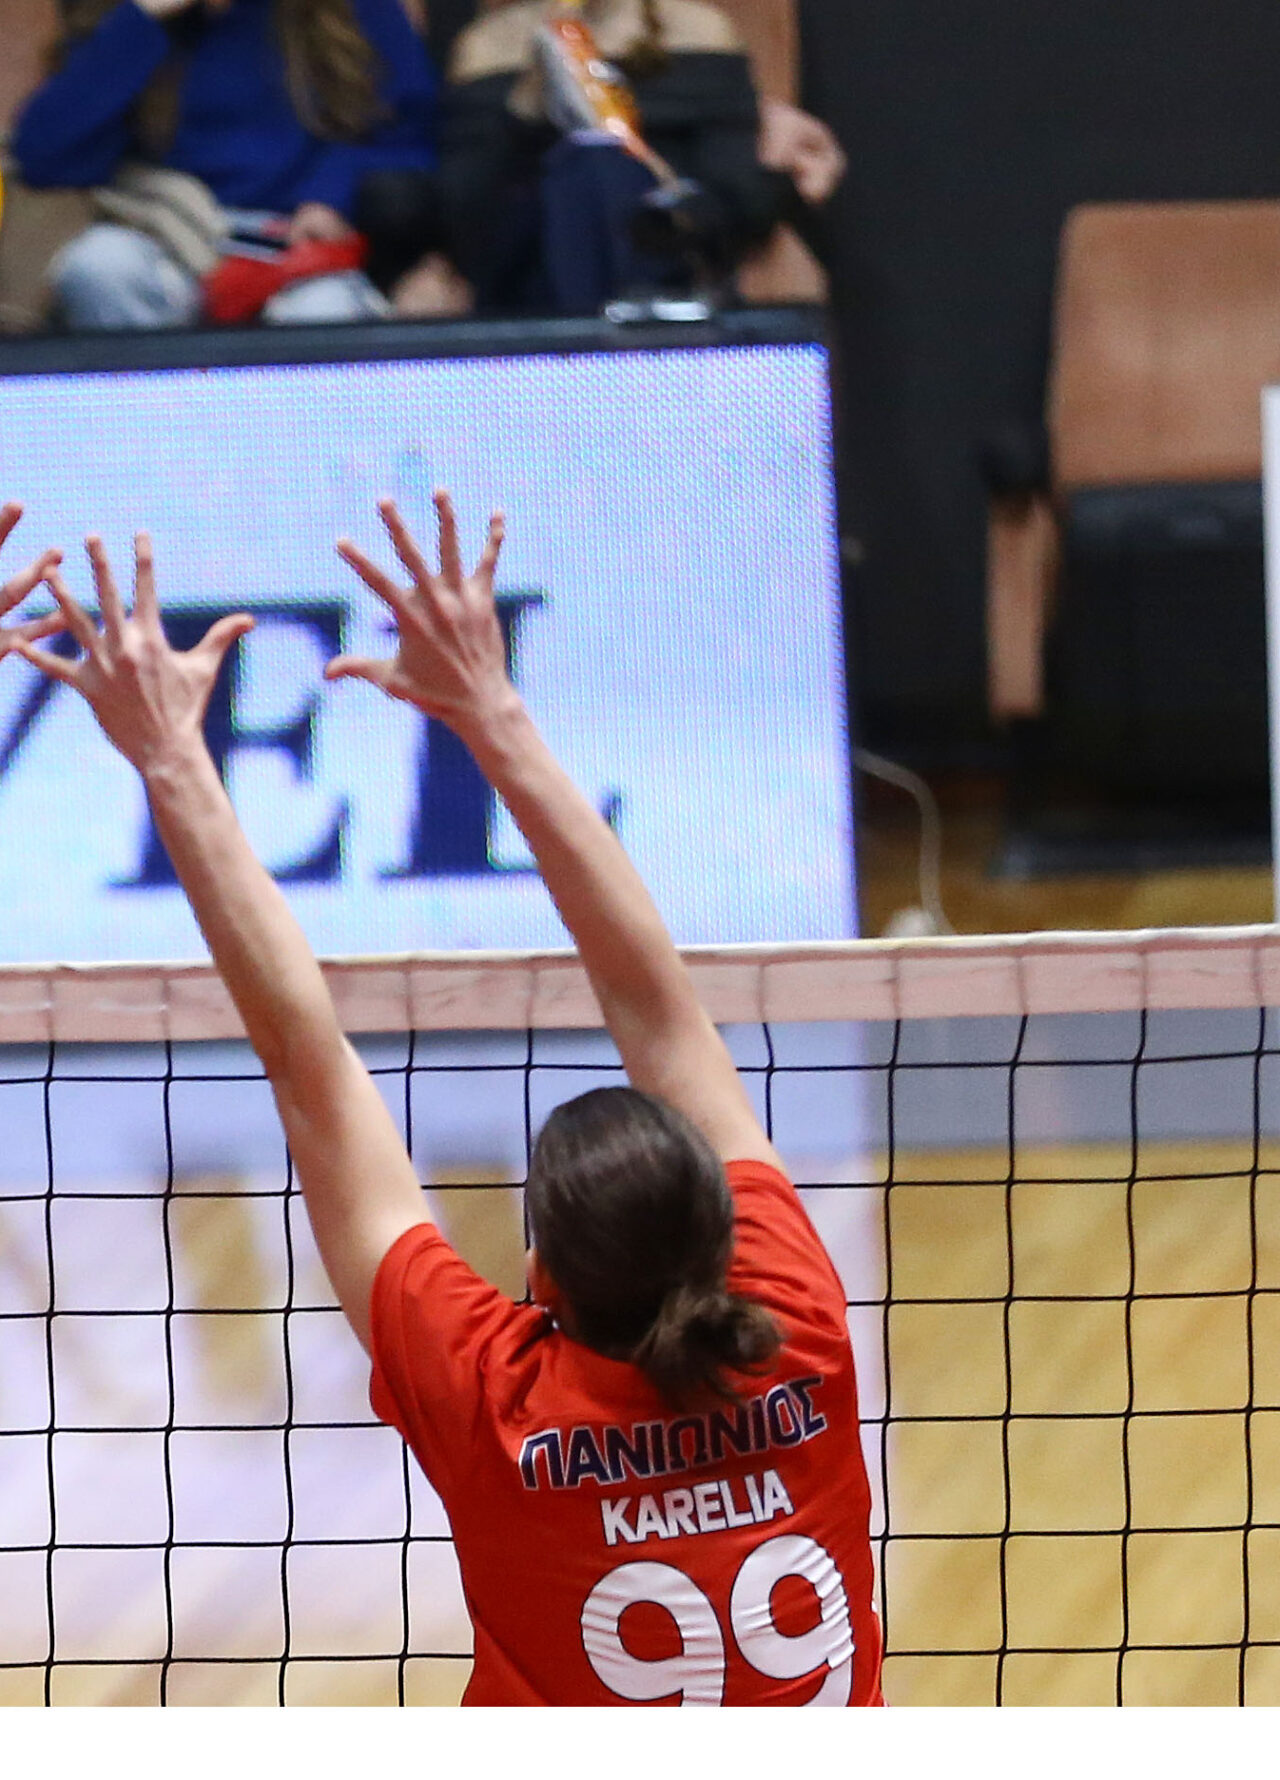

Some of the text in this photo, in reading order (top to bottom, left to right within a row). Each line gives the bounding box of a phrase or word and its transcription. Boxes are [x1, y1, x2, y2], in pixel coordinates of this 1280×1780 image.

[519, 1375, 827, 1491] ΠΑΝΙΩΝΙΟΣ
[601, 1468, 794, 1545] KARELIA
[580, 1533, 856, 1707] 99
